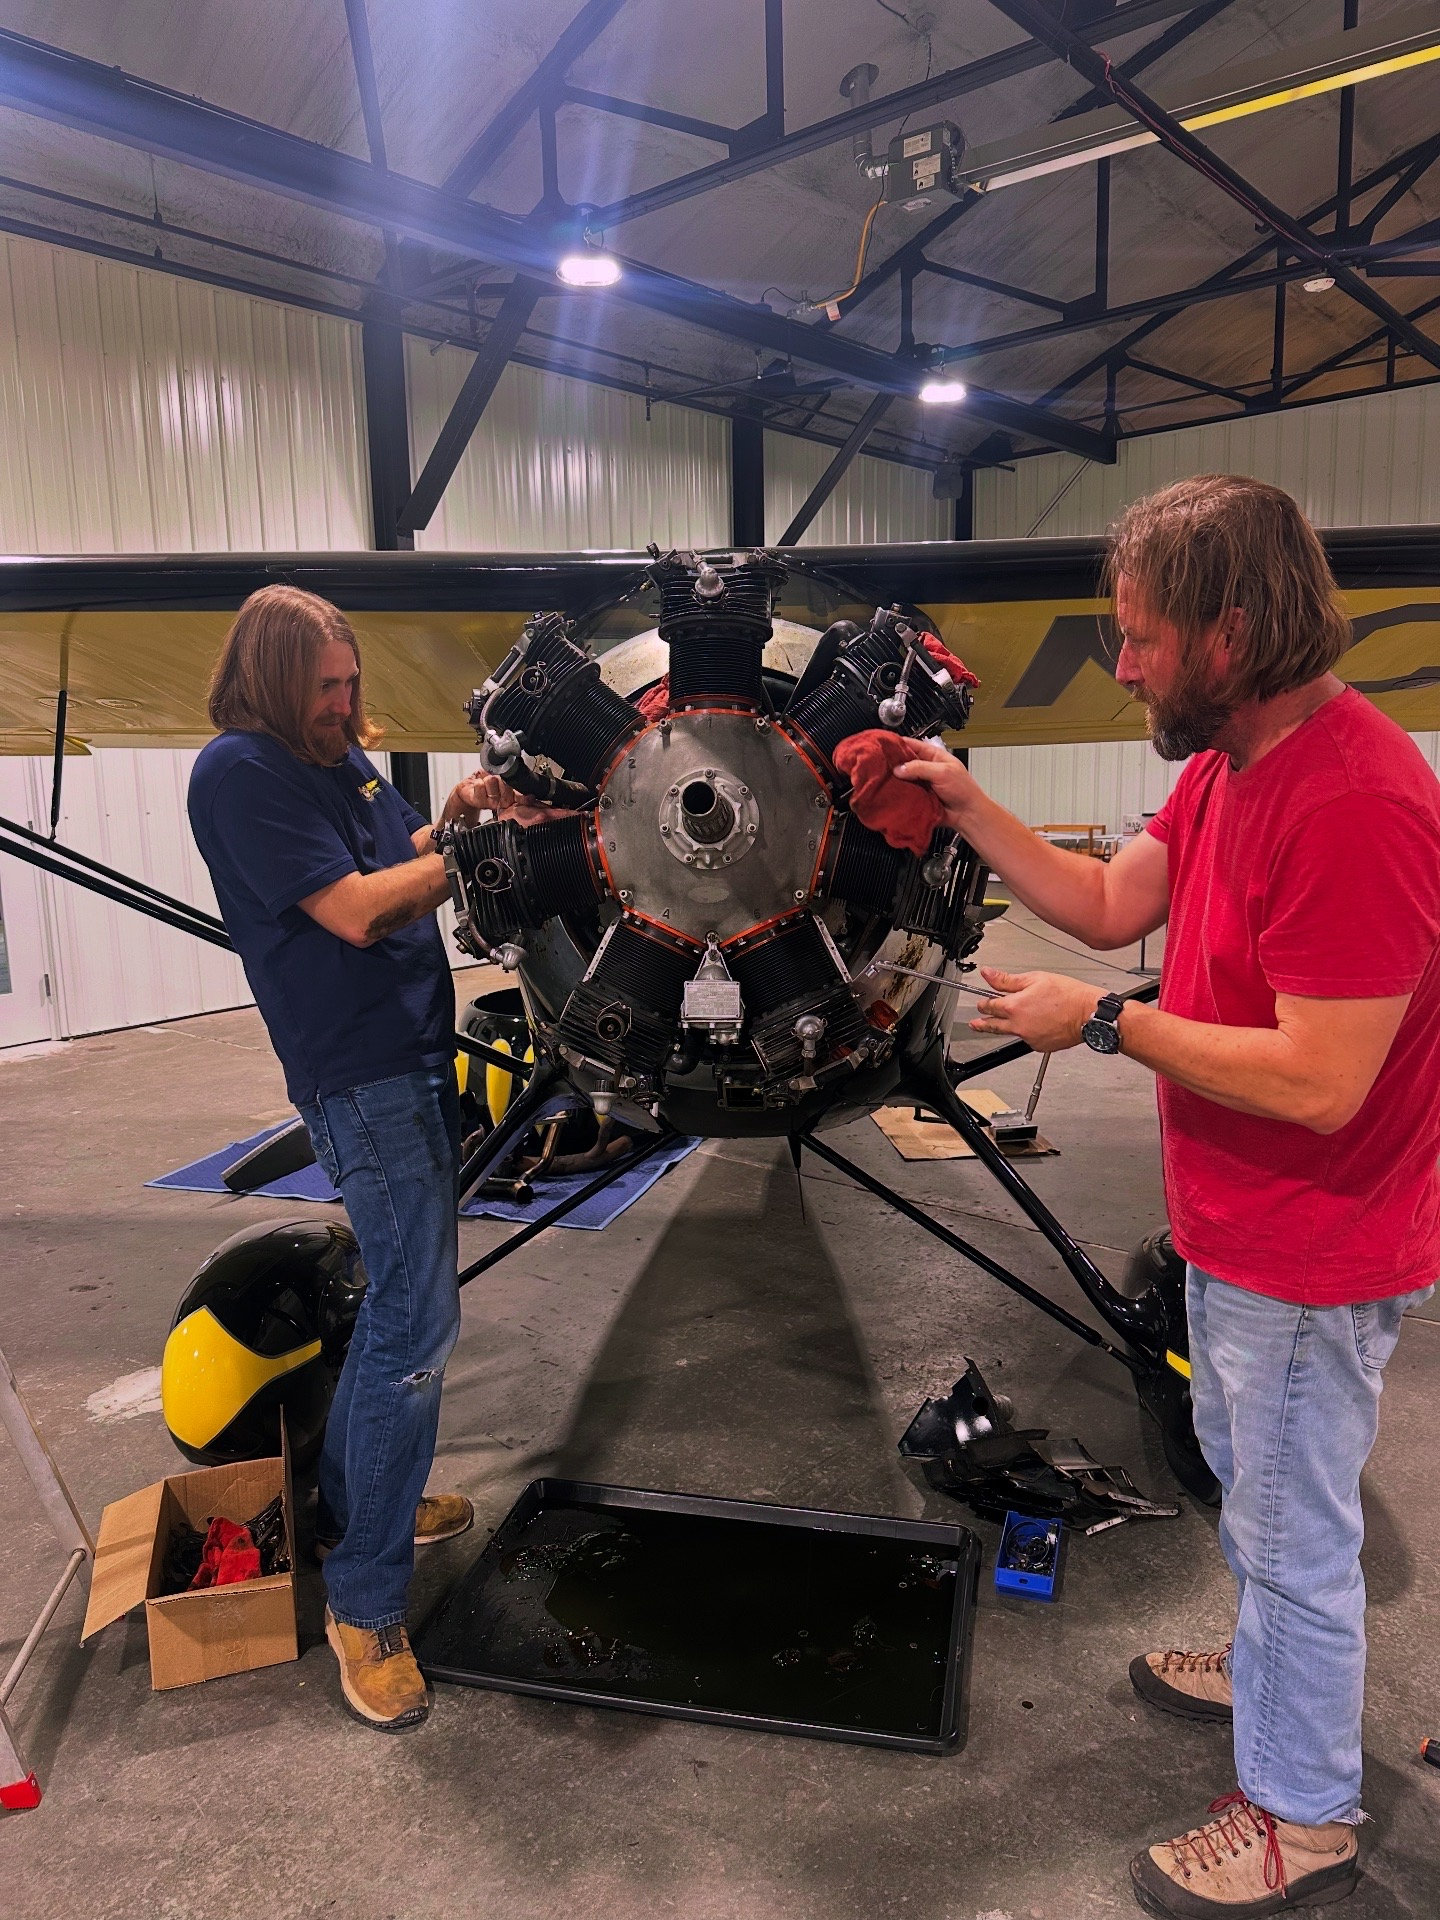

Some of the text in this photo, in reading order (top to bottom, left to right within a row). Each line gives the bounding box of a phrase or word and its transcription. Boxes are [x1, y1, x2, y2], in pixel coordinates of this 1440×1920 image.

[628, 757, 637, 769] 2
[783, 753, 793, 765] 7
[609, 841, 617, 852] 3
[808, 839, 816, 851] 6
[662, 908, 670, 920] 4
